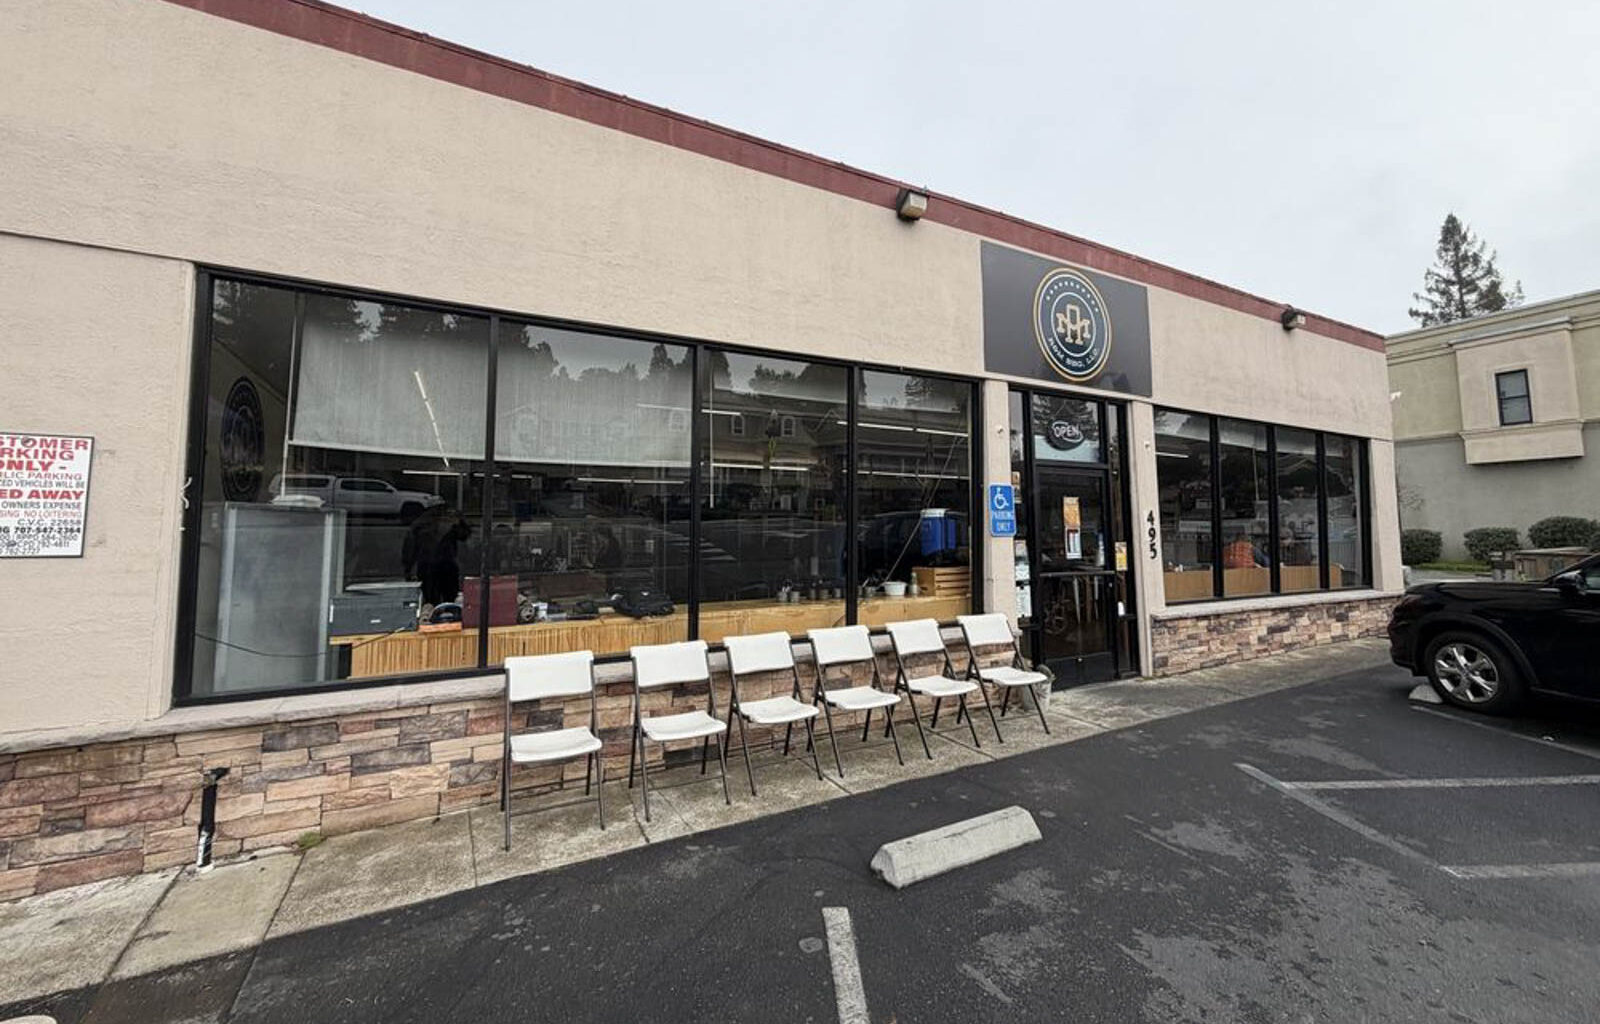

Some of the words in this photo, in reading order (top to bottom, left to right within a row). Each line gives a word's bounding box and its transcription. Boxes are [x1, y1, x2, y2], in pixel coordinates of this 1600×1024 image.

[1054, 423, 1080, 438] OPEN
[0, 471, 24, 479] LIC
[27, 472, 82, 480] PARKING
[14, 480, 54, 488] VEHICLES
[27, 489, 84, 499] AWAY
[1, 500, 40, 509] OWNERS
[43, 501, 82, 510] EXPENSE
[0, 526, 10, 534] G
[1147, 510, 1157, 560] 495
